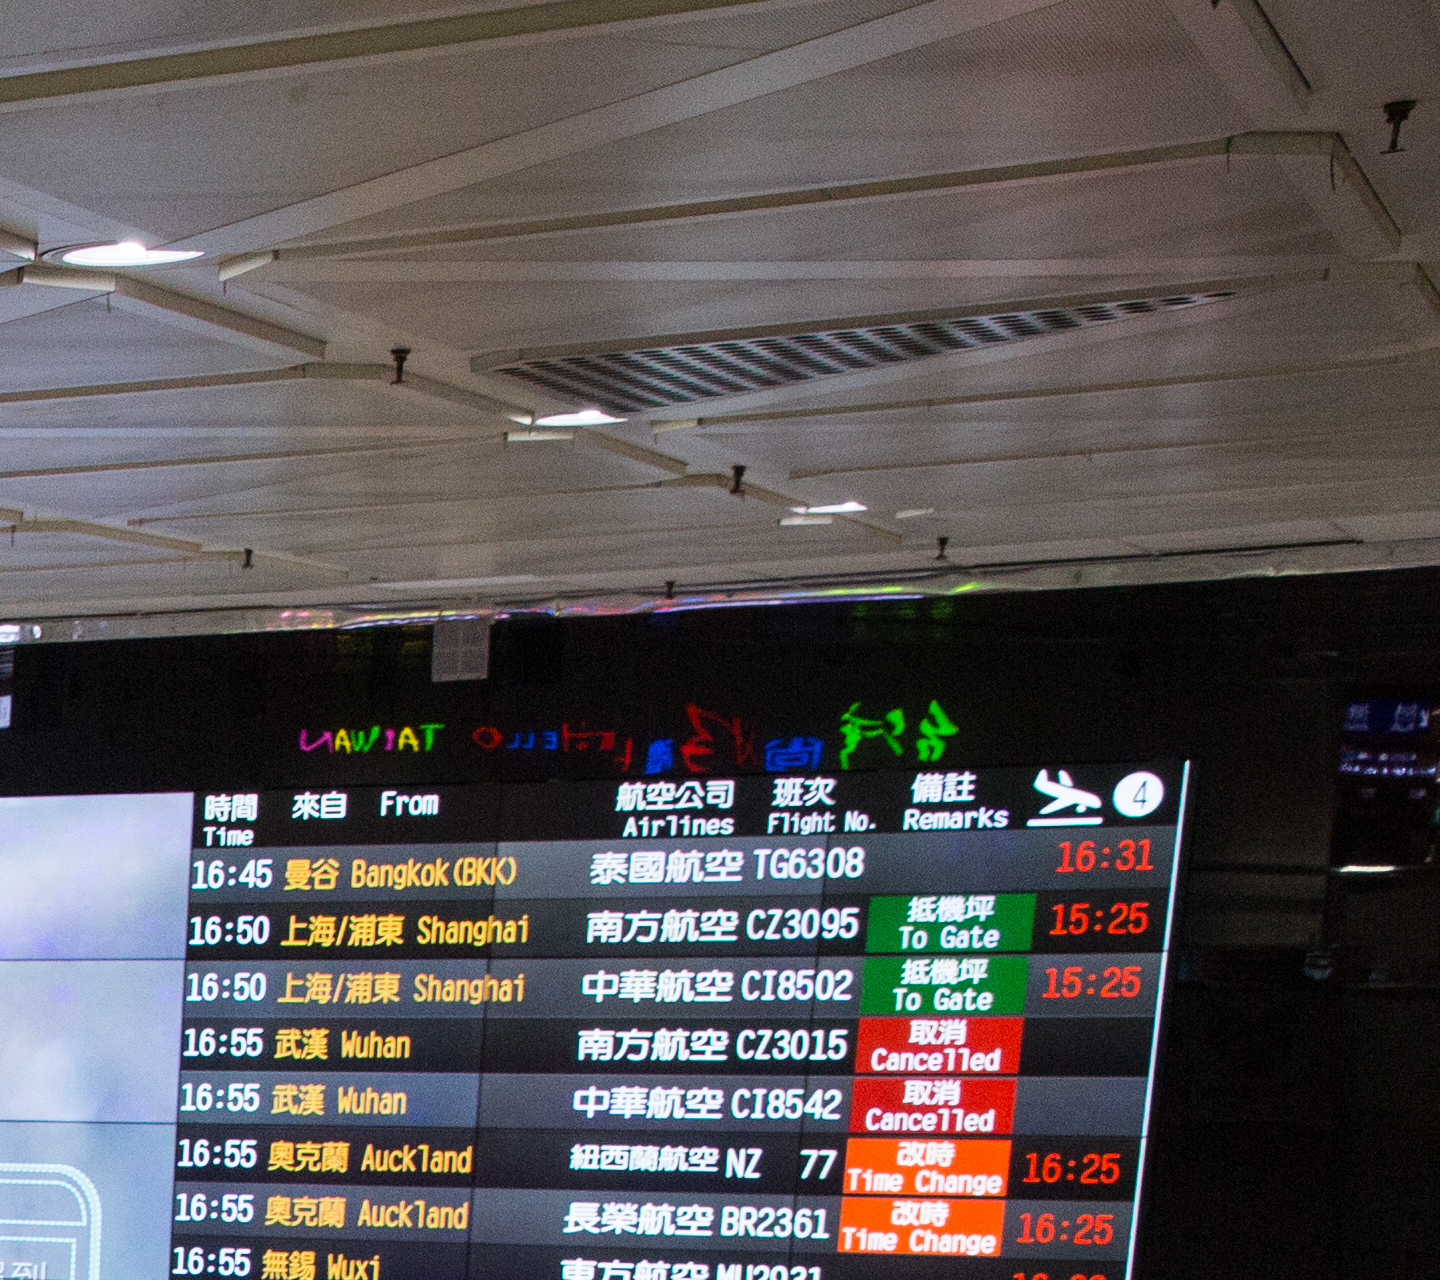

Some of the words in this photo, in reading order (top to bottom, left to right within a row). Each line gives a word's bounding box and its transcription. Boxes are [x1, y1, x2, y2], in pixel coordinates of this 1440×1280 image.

[204, 793, 259, 822] 時間
[292, 790, 348, 820] 來自
[380, 790, 440, 817] From
[615, 780, 735, 811] 航空公司
[771, 776, 836, 807] 班次
[911, 771, 977, 803] 備註
[1133, 781, 1147, 809] 4
[202, 826, 255, 847] Time
[622, 815, 735, 837] Airlines
[768, 811, 836, 835] Flight
[844, 810, 876, 832] No.
[903, 806, 1009, 831] Remarks
[191, 858, 274, 889] 16:45
[285, 858, 340, 890] 曼谷
[351, 856, 518, 890] Bangkok(BKK)
[590, 848, 745, 885] 泰國航空
[753, 846, 866, 880] TG6308
[1055, 839, 1154, 873] 16:31
[188, 915, 270, 945] 16:50
[281, 913, 405, 947] 上海/浦東
[417, 914, 529, 947] Shanghai
[586, 908, 739, 943] 南方航空
[746, 907, 860, 940] CZ3095
[1049, 902, 1149, 936] 15:25
[907, 894, 996, 923] 抵機坪
[898, 925, 929, 949] To
[940, 924, 1001, 949] Gate
[183, 1027, 264, 1057] 16:55
[275, 1027, 330, 1059] 武漢
[342, 1030, 411, 1058] Wuhan
[578, 1027, 730, 1061] 南方航空
[736, 1029, 849, 1061] CZ3015
[908, 1018, 967, 1046] 取消
[870, 1047, 1002, 1072] Cancelled
[177, 1138, 258, 1168] 16:55
[269, 1139, 350, 1173] 奧克蘭
[362, 1143, 473, 1173] Auckland
[570, 1143, 720, 1172] 紐西蘭航空
[726, 1147, 763, 1179] NZ
[800, 1149, 838, 1180] 77
[1022, 1152, 1121, 1184] 16:25
[896, 1140, 956, 1168] 改時
[847, 1167, 905, 1193] Time
[914, 1168, 1003, 1197] Change
[171, 1246, 252, 1277] 16:55
[263, 1249, 316, 1280] 無錫
